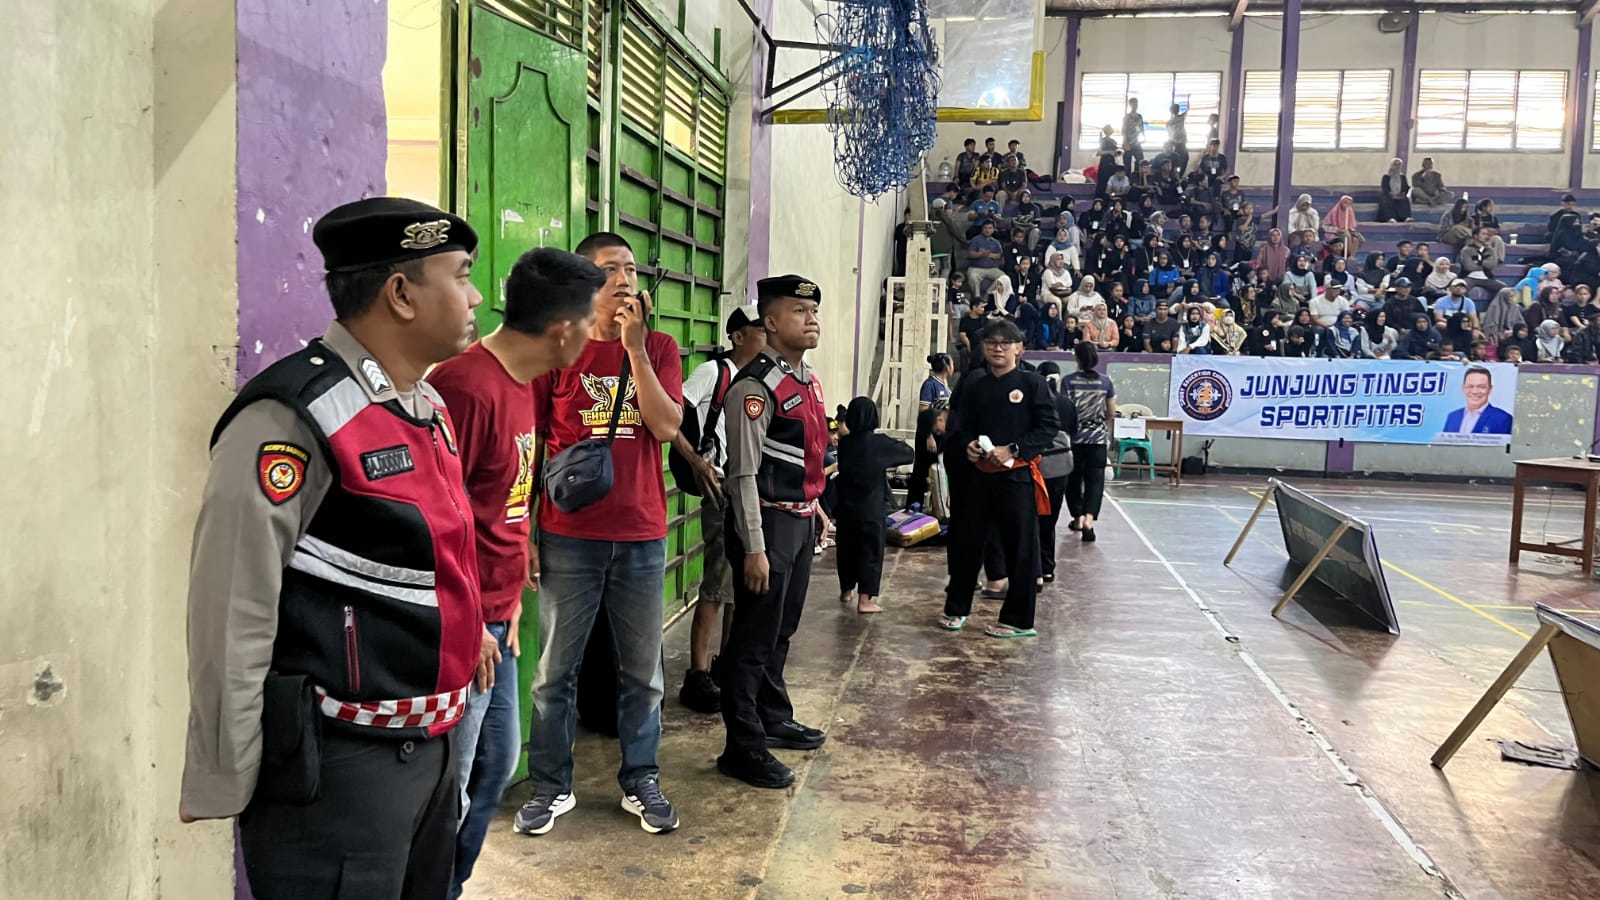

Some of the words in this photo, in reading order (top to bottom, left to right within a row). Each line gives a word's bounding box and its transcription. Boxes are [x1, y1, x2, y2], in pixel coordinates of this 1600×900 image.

[1239, 373, 1358, 397] JUNJUNG
[1362, 371, 1447, 395] TINGGI
[1260, 403, 1424, 427] SPORTIFITAS
